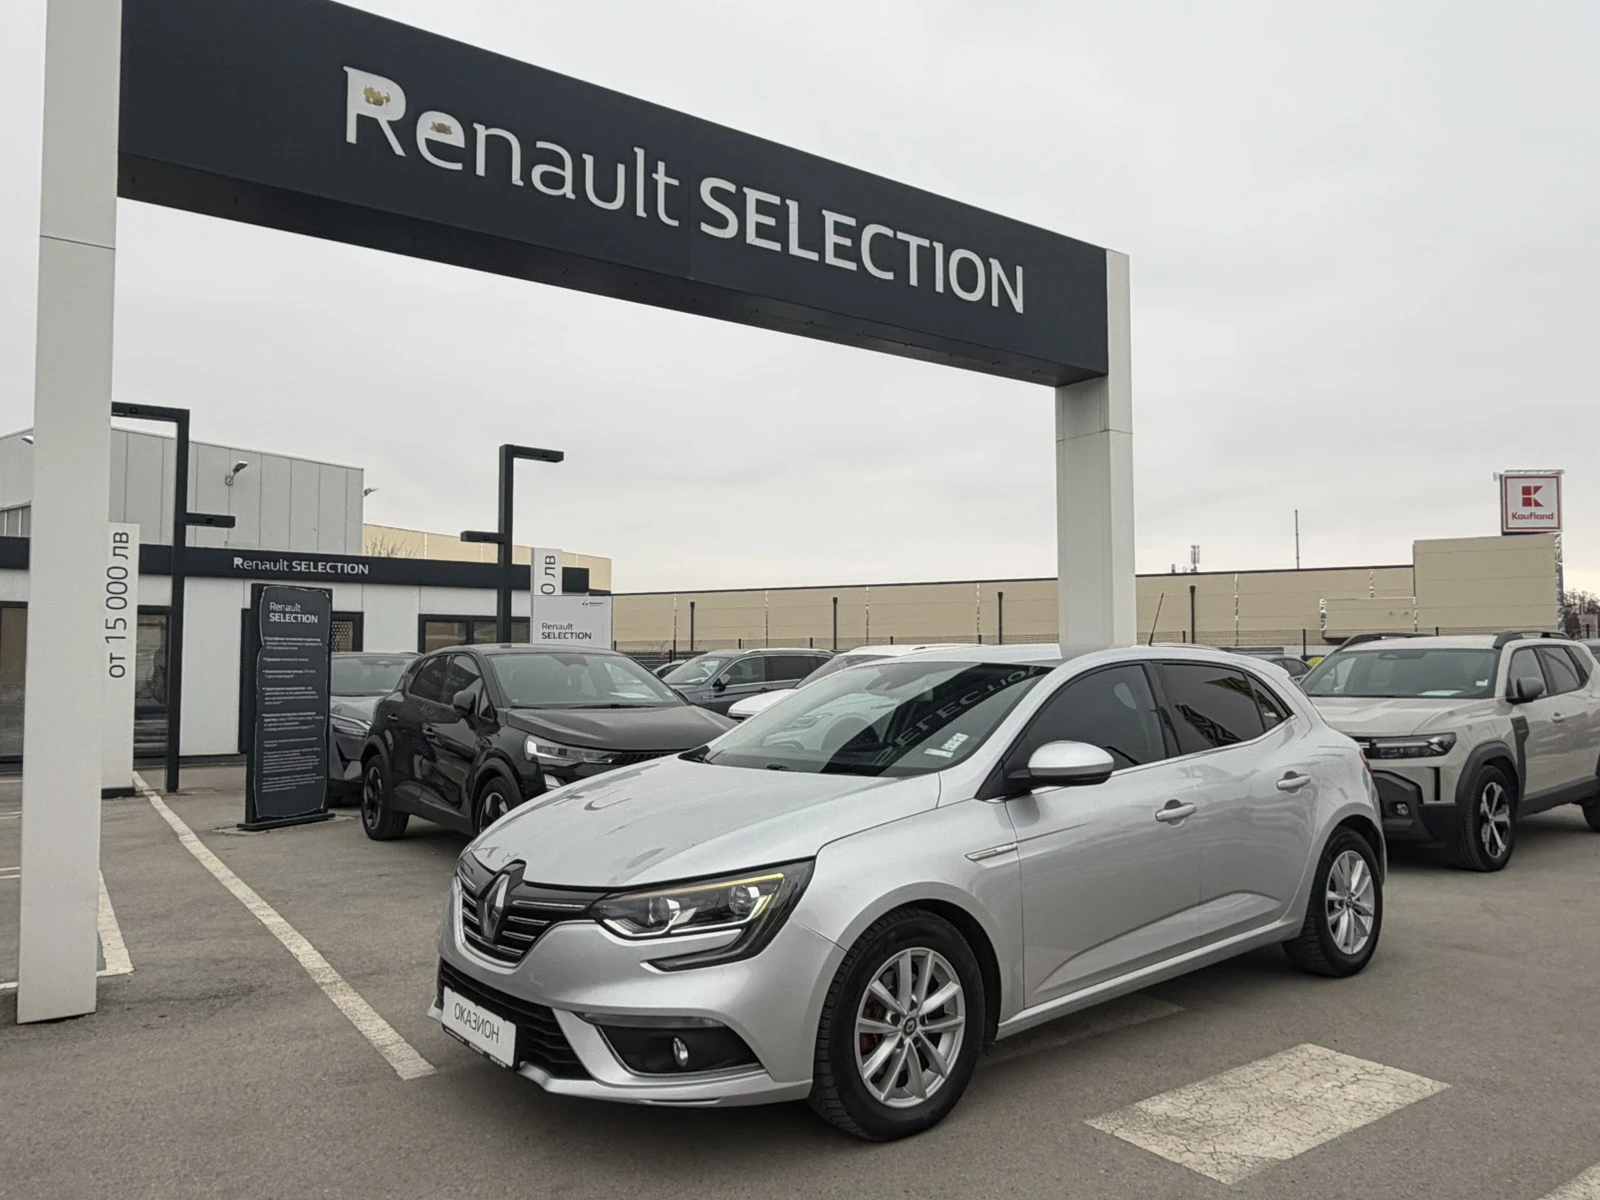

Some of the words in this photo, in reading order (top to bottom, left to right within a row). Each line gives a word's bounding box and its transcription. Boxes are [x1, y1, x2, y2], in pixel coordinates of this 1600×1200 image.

[343, 65, 680, 227] Renault
[699, 176, 1024, 314] SELECTION
[1511, 511, 1554, 520] Kaufland
[233, 556, 290, 572] Renault
[292, 560, 369, 575] SELECTION
[105, 565, 129, 610] 000
[269, 602, 302, 613] Renault
[269, 612, 318, 624] SELECTION
[105, 617, 127, 644] 15
[541, 622, 574, 631] Renault
[541, 631, 592, 640] SELECTION
[454, 1002, 500, 1044] ОКАЗИОН
